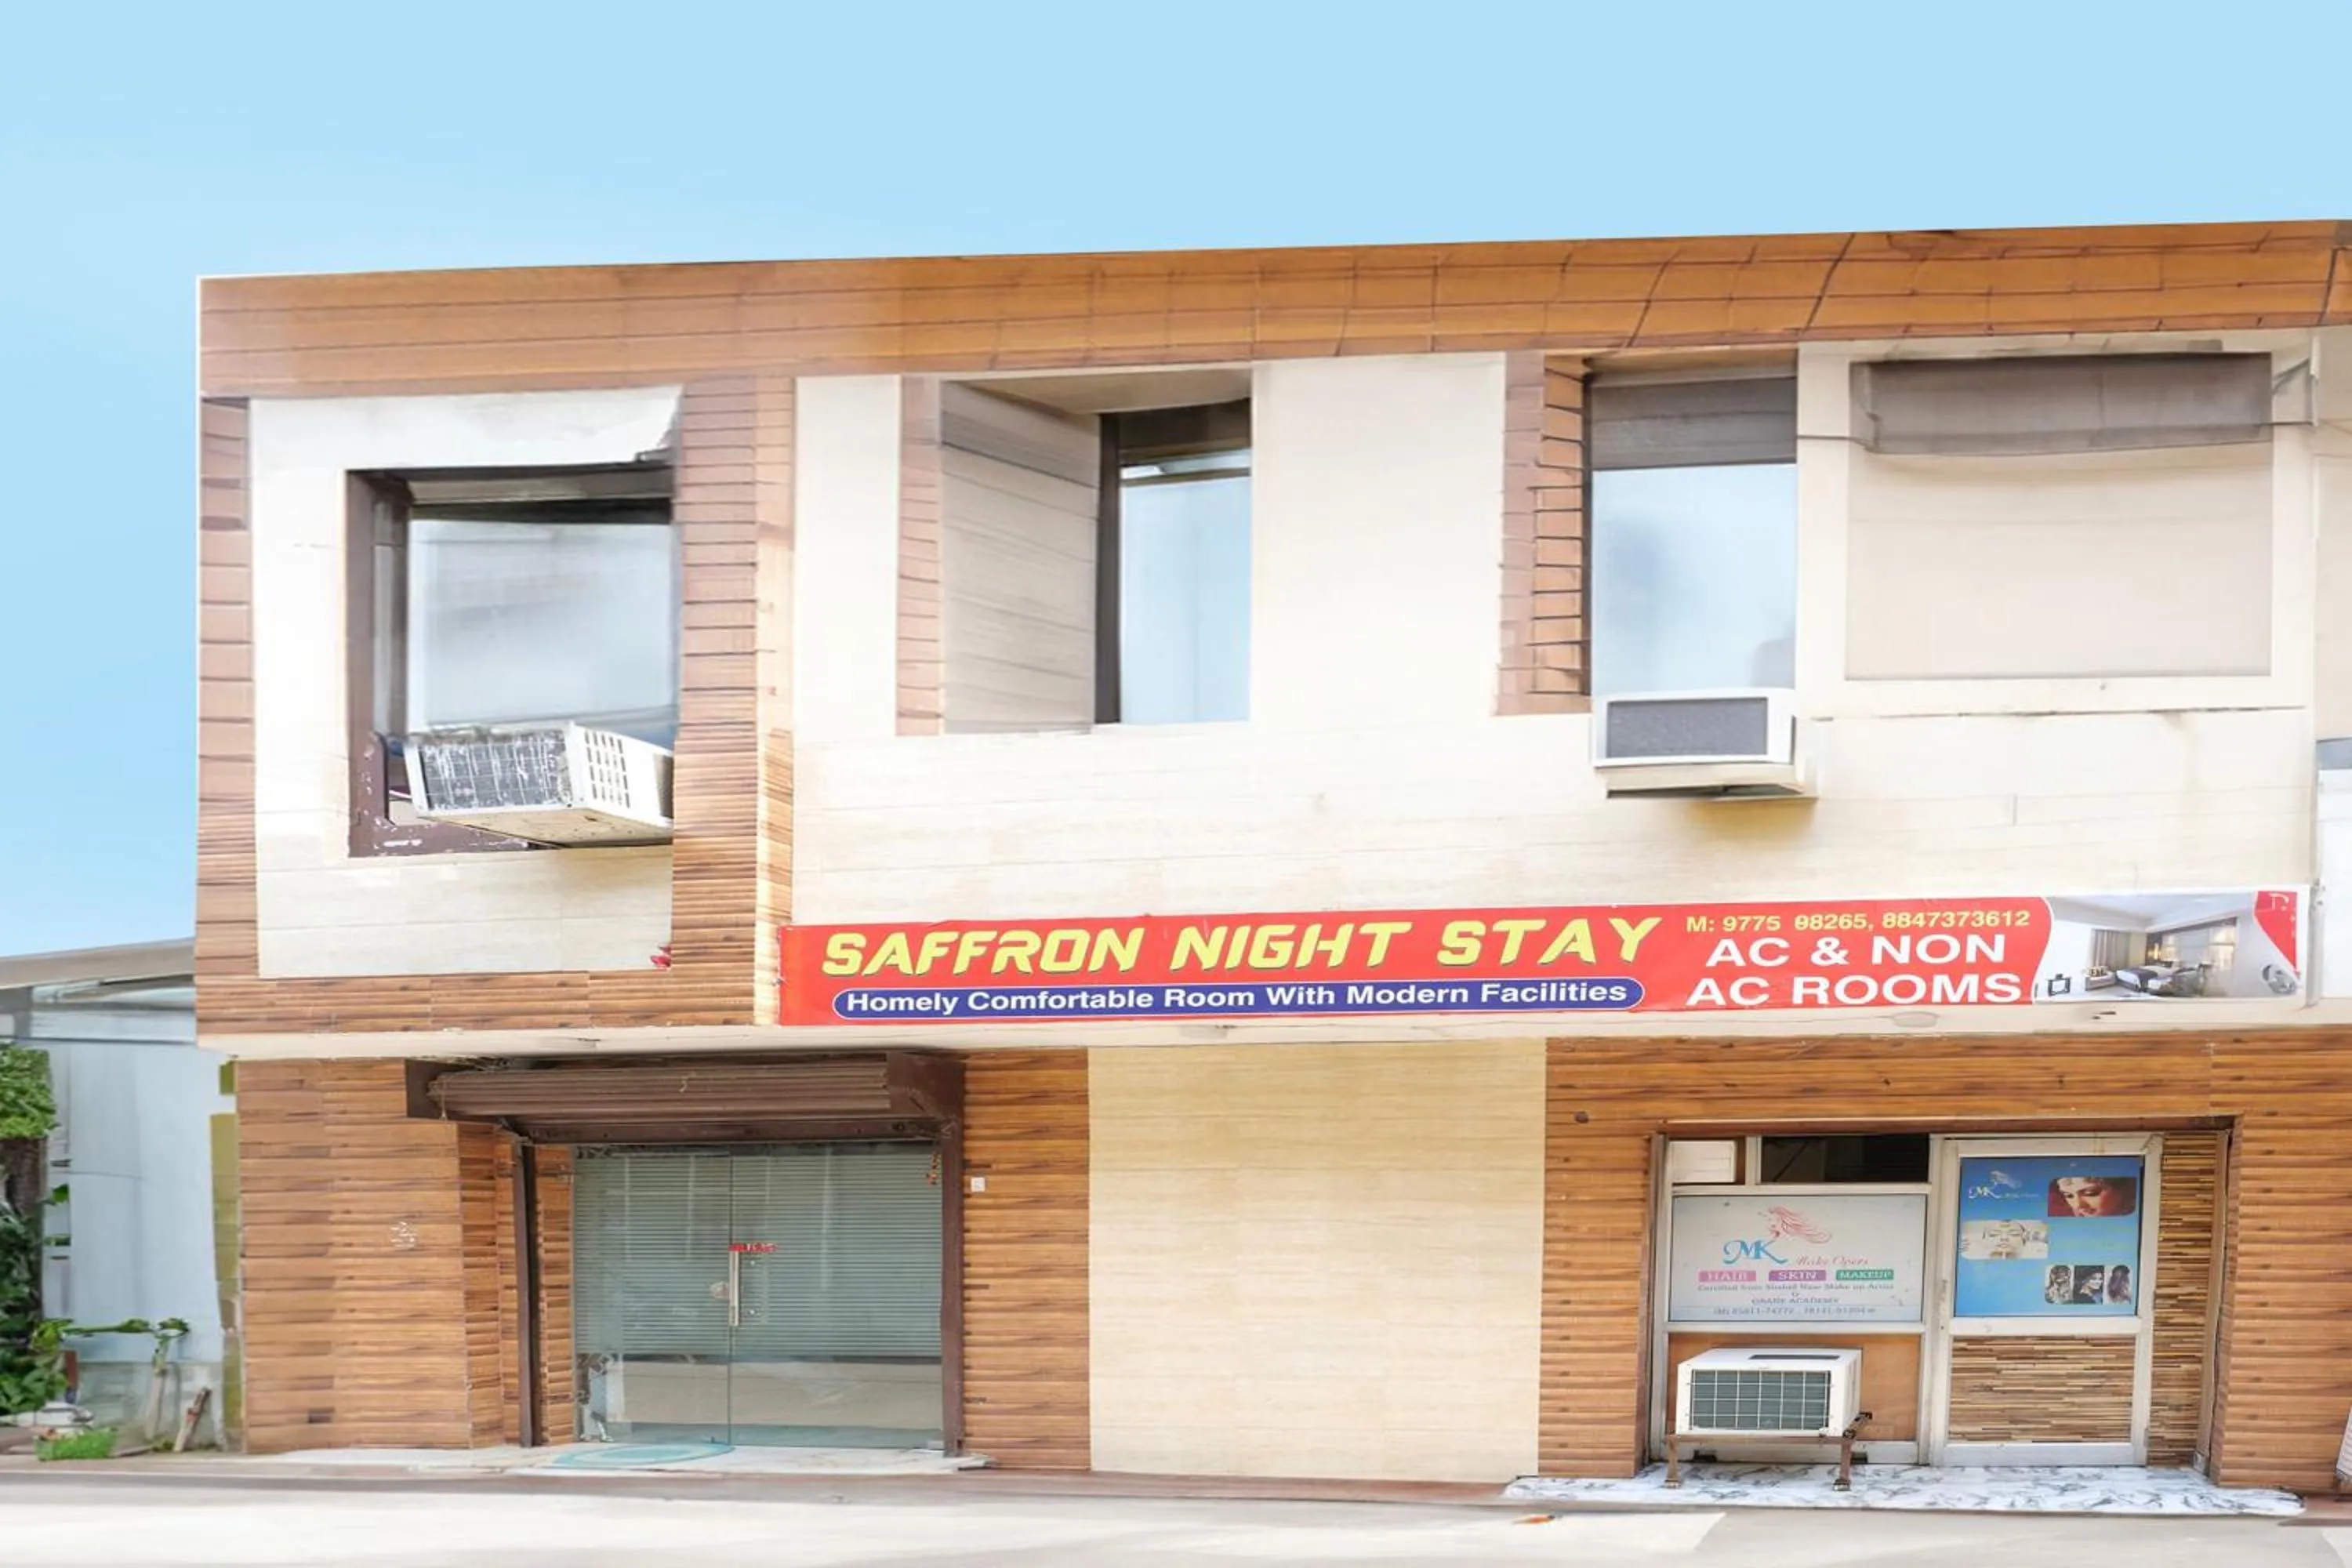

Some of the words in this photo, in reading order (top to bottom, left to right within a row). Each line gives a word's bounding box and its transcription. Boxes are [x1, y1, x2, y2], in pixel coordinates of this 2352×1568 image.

[1686, 916, 1715, 932] M:
[1722, 916, 1781, 931] 9775
[1882, 910, 2031, 929] 8847373612
[822, 927, 1144, 975] SAFFRON
[1170, 921, 1412, 970] NIGHT
[1437, 916, 1662, 966] STAY
[1705, 938, 1790, 967] AC
[1811, 937, 1849, 965] &
[1872, 934, 2005, 964] NON
[847, 993, 958, 1015] Homely
[967, 989, 1153, 1010] Comfortable
[1164, 989, 1255, 1007] Room
[1266, 985, 1336, 1004] With
[1347, 984, 1468, 1004] Modern
[1481, 982, 1628, 1003] Facilities
[1686, 977, 1769, 1006] AC
[1792, 974, 2021, 1004] ROOMS
[1777, 1270, 1817, 1280] SKIN
